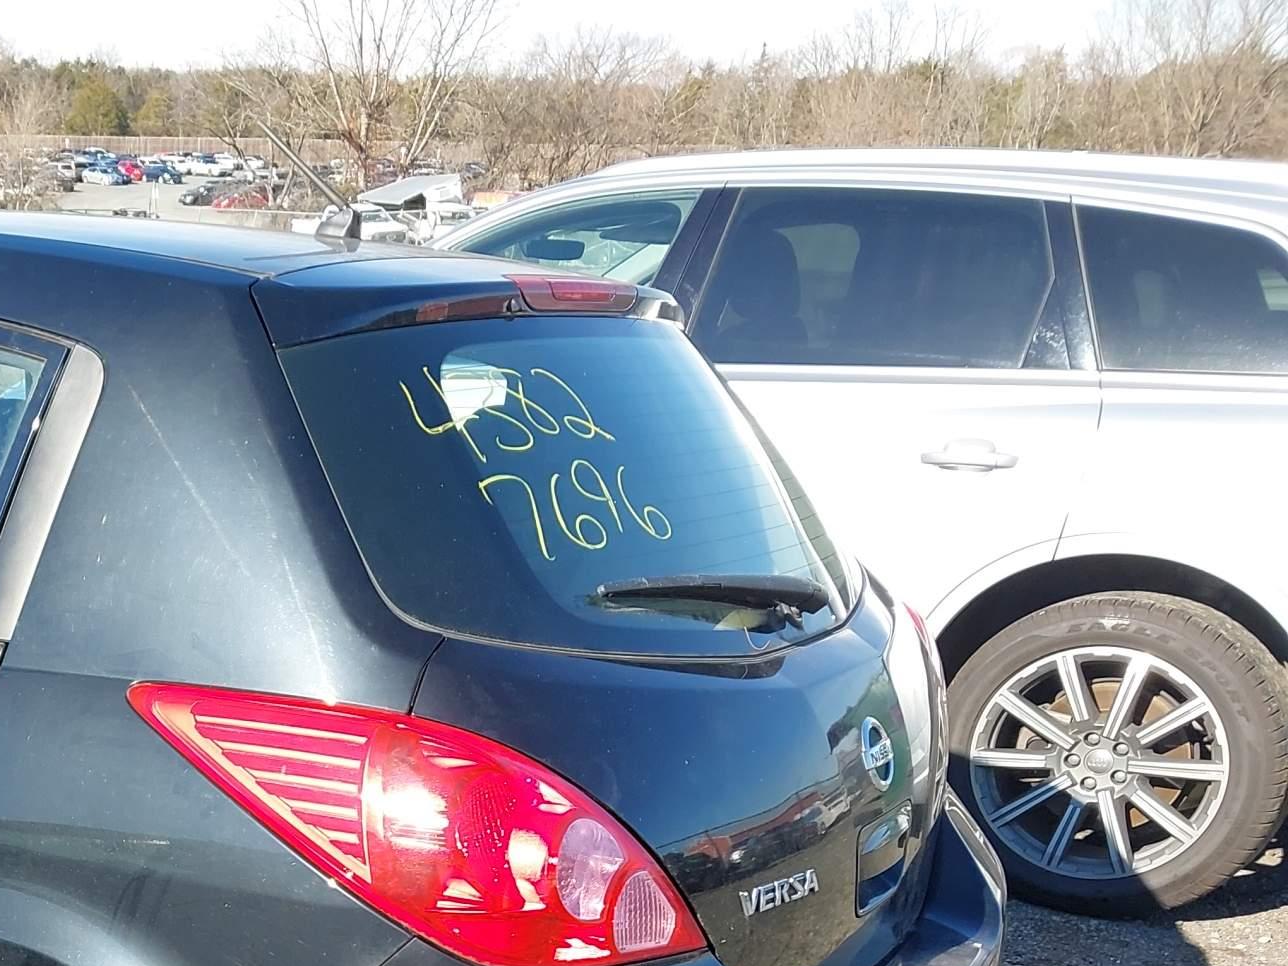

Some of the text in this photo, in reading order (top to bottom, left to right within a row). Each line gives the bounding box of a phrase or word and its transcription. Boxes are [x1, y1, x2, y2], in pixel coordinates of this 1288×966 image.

[399, 366, 616, 463] 4382
[478, 459, 673, 562] 7696
[1066, 621, 1177, 645] EAGLE
[738, 868, 821, 917] VERSA
